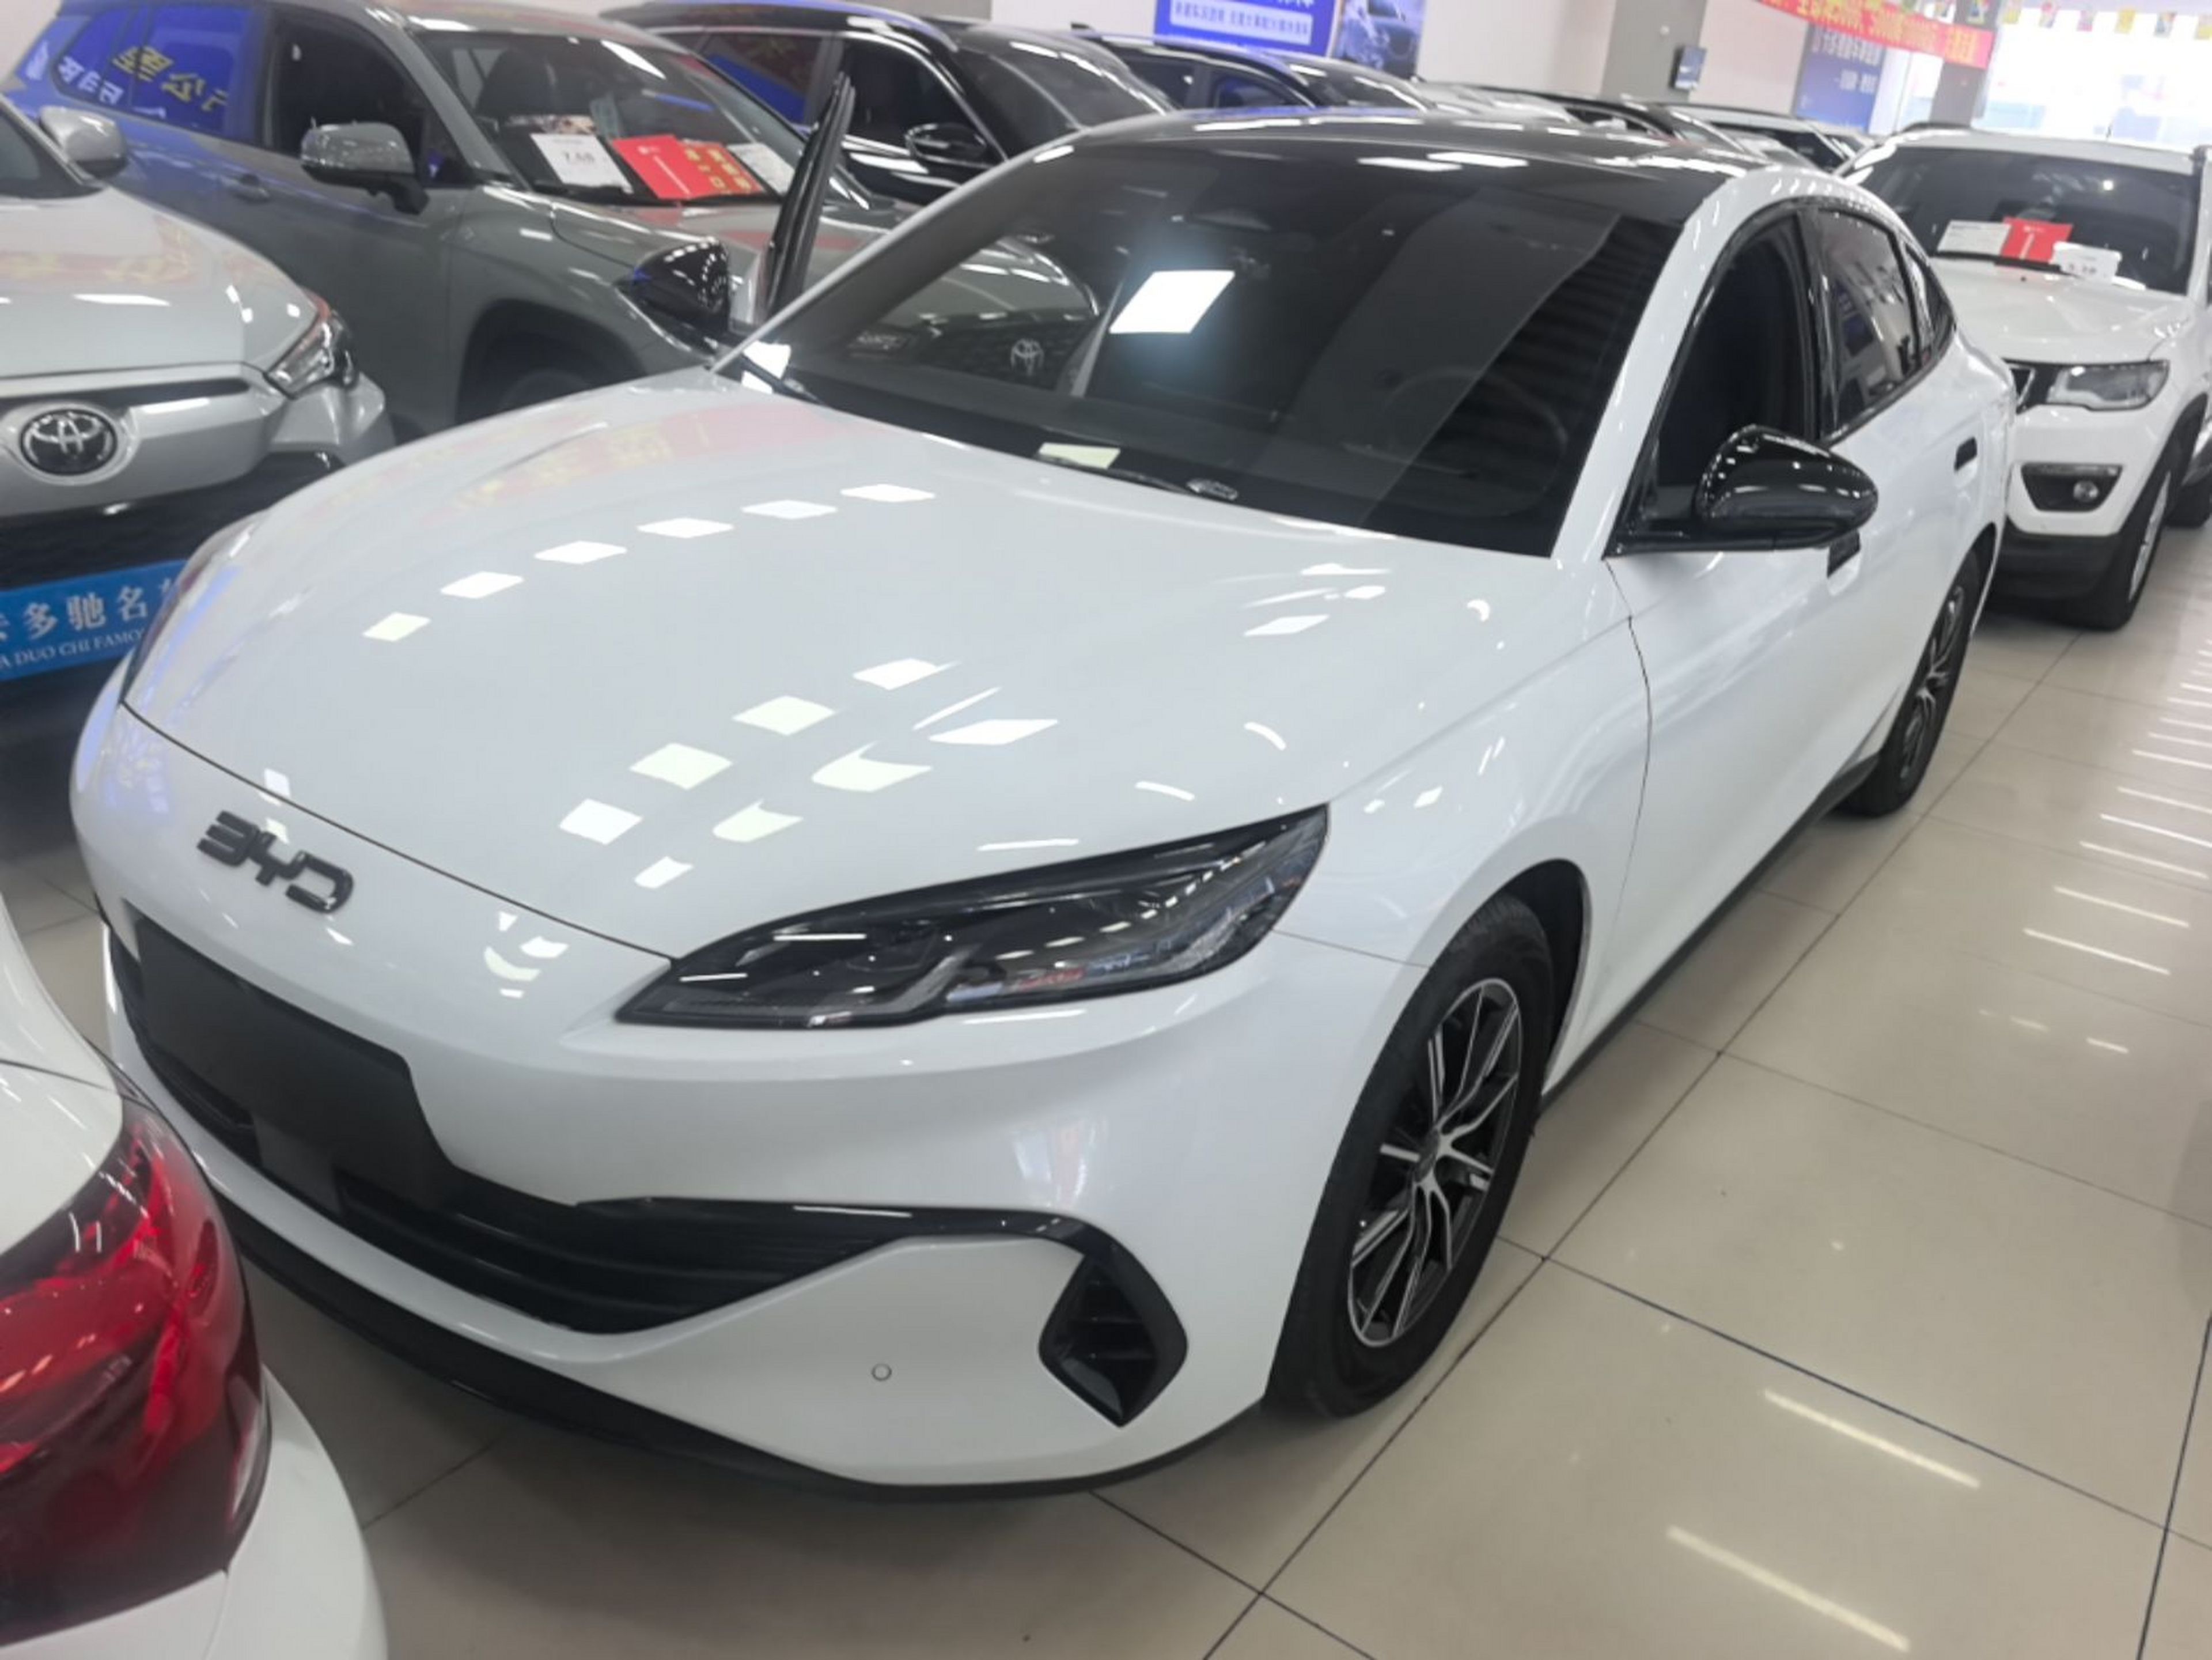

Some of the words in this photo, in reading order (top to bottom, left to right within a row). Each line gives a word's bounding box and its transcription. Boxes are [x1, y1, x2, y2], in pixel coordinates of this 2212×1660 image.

[0, 578, 172, 640] 多驰名
[14, 646, 56, 666] DUO
[59, 638, 90, 656] CHI
[94, 627, 145, 650] FAMO
[196, 810, 353, 913] BYD
